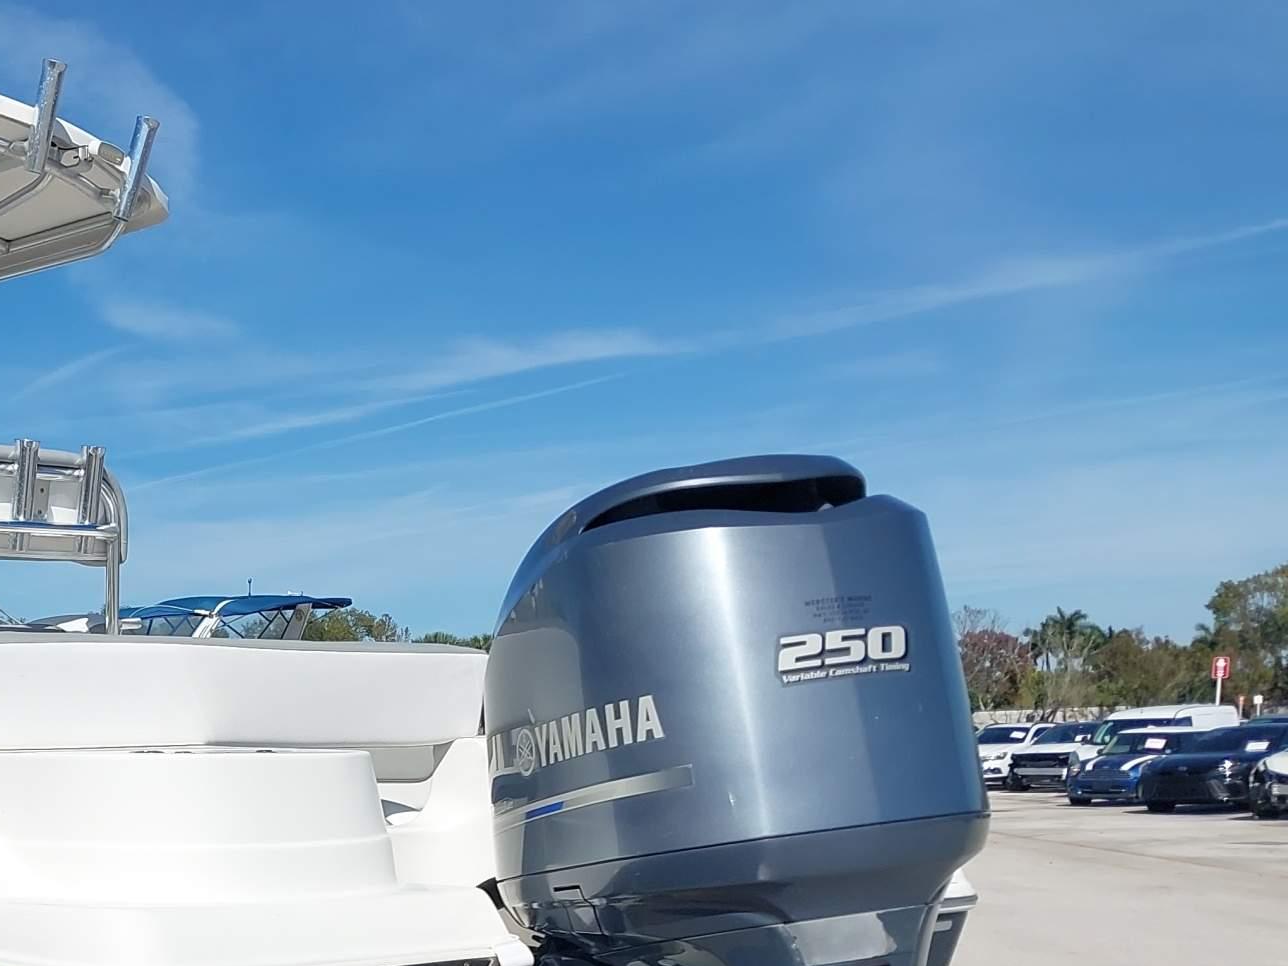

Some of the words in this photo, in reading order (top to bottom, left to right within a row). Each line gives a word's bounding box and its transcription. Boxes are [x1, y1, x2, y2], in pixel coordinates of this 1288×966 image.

[778, 625, 906, 672] 250
[782, 670, 827, 683] Variable
[829, 664, 877, 677] Camshaft
[879, 661, 911, 672] Timing
[534, 694, 665, 768] YAMAHA
